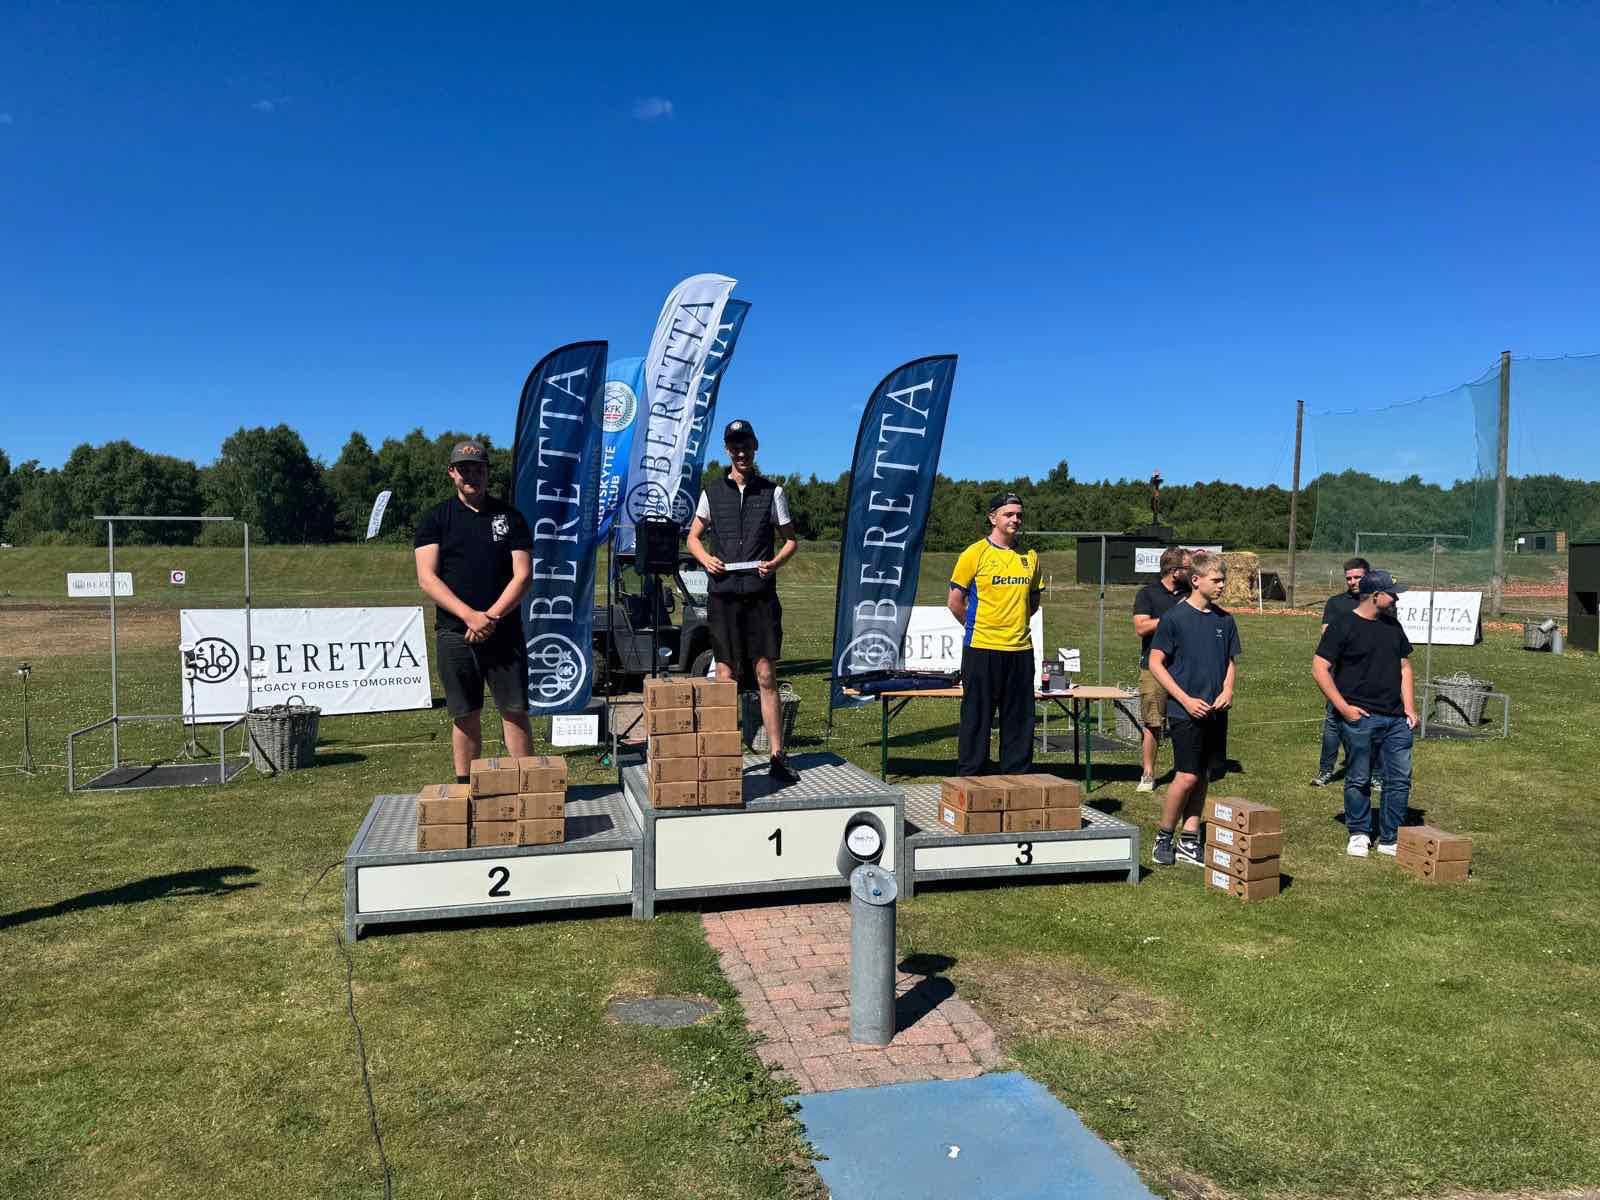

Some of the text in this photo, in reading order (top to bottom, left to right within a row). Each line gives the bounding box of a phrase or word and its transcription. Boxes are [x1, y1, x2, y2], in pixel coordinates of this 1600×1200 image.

[640, 301, 715, 475] BERETTA
[529, 367, 588, 623] BERETTA
[608, 475, 620, 511] KLUB
[856, 378, 934, 625] BERETTA
[173, 571, 184, 582] C
[991, 575, 1030, 585] Betano
[1397, 607, 1473, 623] RETTA
[301, 679, 350, 690] FORGES
[353, 675, 422, 687] TOMORROW
[768, 827, 782, 857] 1
[1015, 841, 1033, 865] 3
[487, 866, 511, 897] 2
